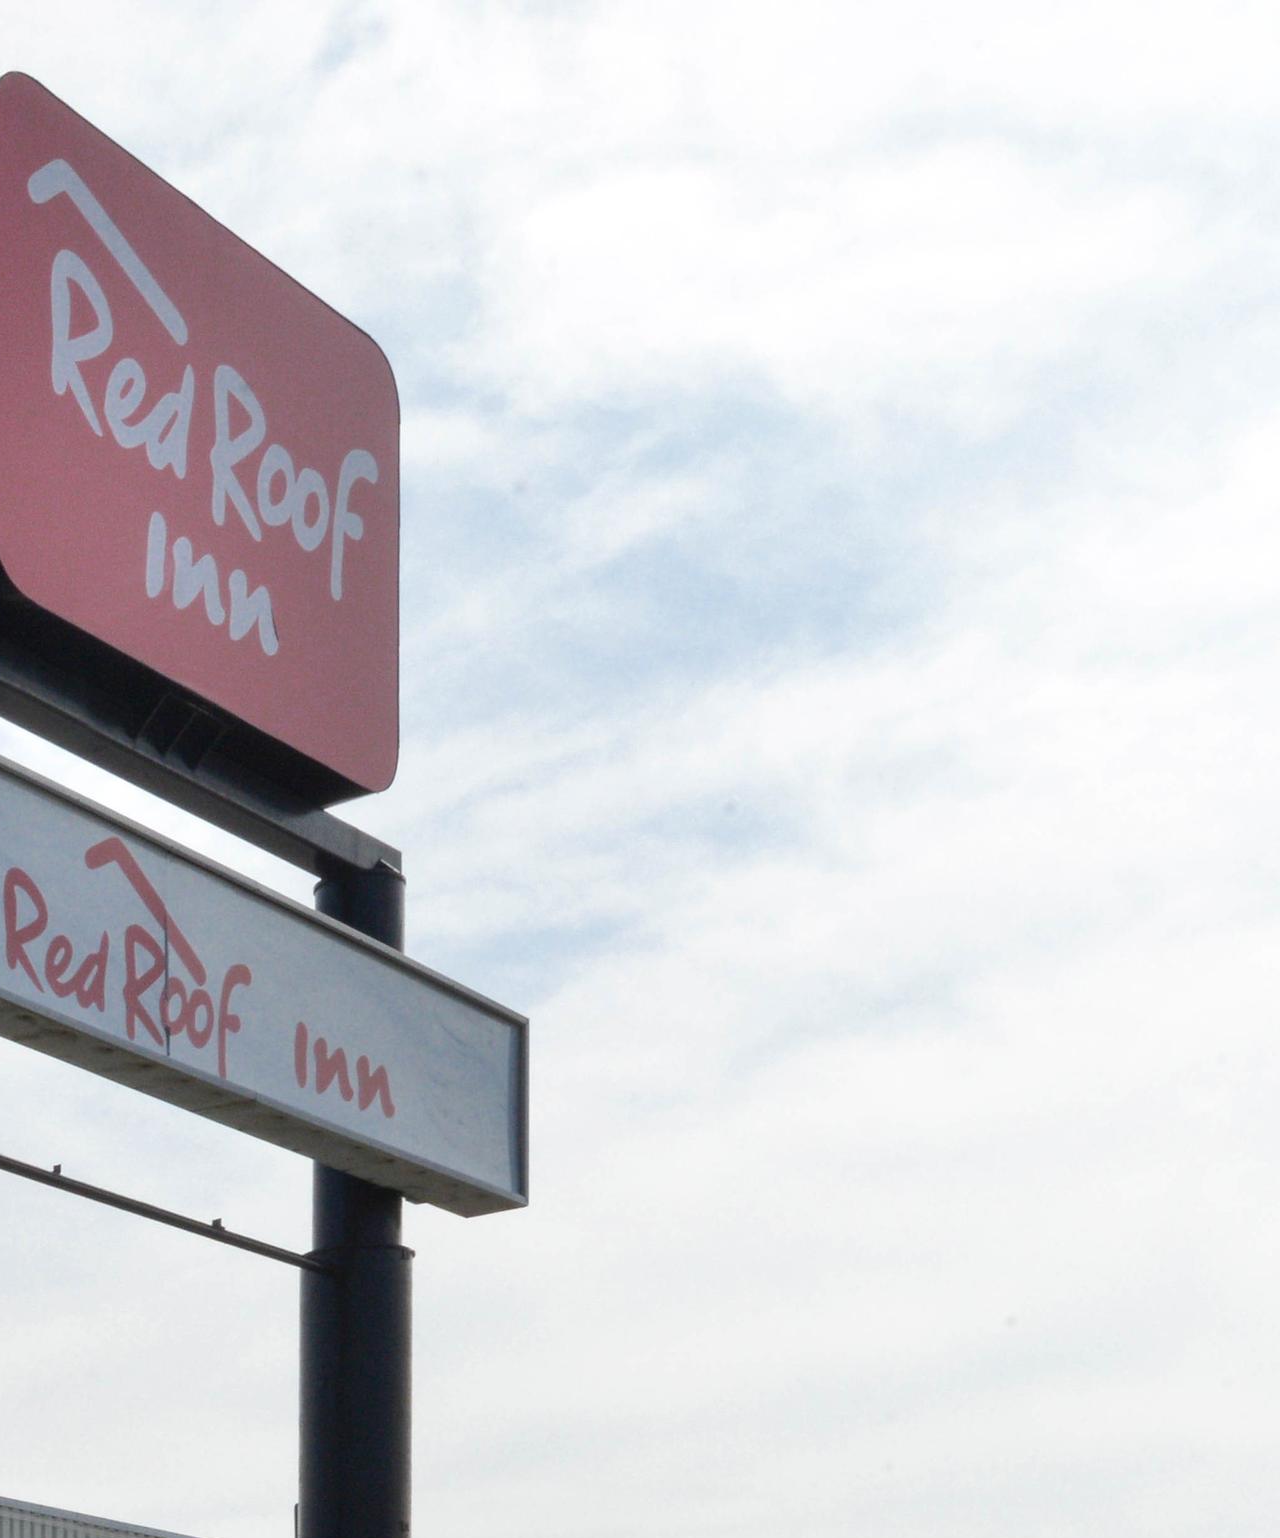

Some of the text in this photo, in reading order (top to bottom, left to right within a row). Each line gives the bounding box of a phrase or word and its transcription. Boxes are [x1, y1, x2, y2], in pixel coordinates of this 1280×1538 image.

[51, 250, 379, 600] Red Roof
[146, 512, 279, 656] Inn
[4, 867, 396, 1117] Red Roof Inn
